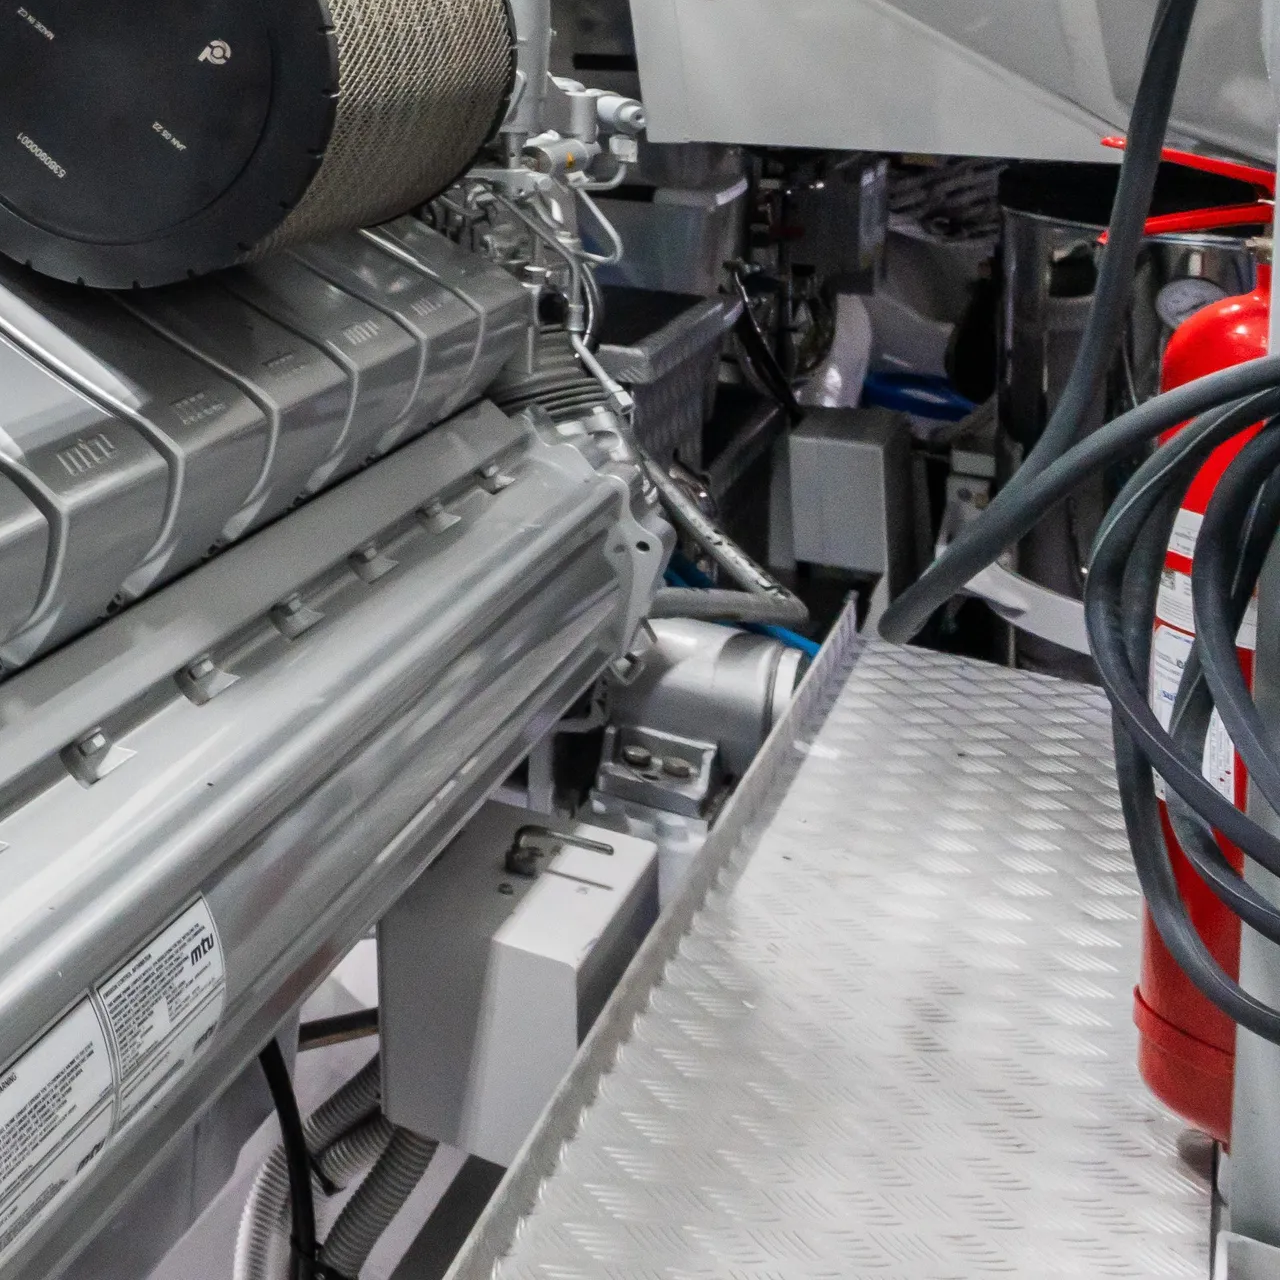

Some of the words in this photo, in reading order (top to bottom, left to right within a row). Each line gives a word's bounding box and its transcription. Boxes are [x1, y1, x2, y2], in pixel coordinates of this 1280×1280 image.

[152, 121, 164, 132] 22
[170, 136, 187, 151] JAN
[190, 933, 214, 966] mtu
